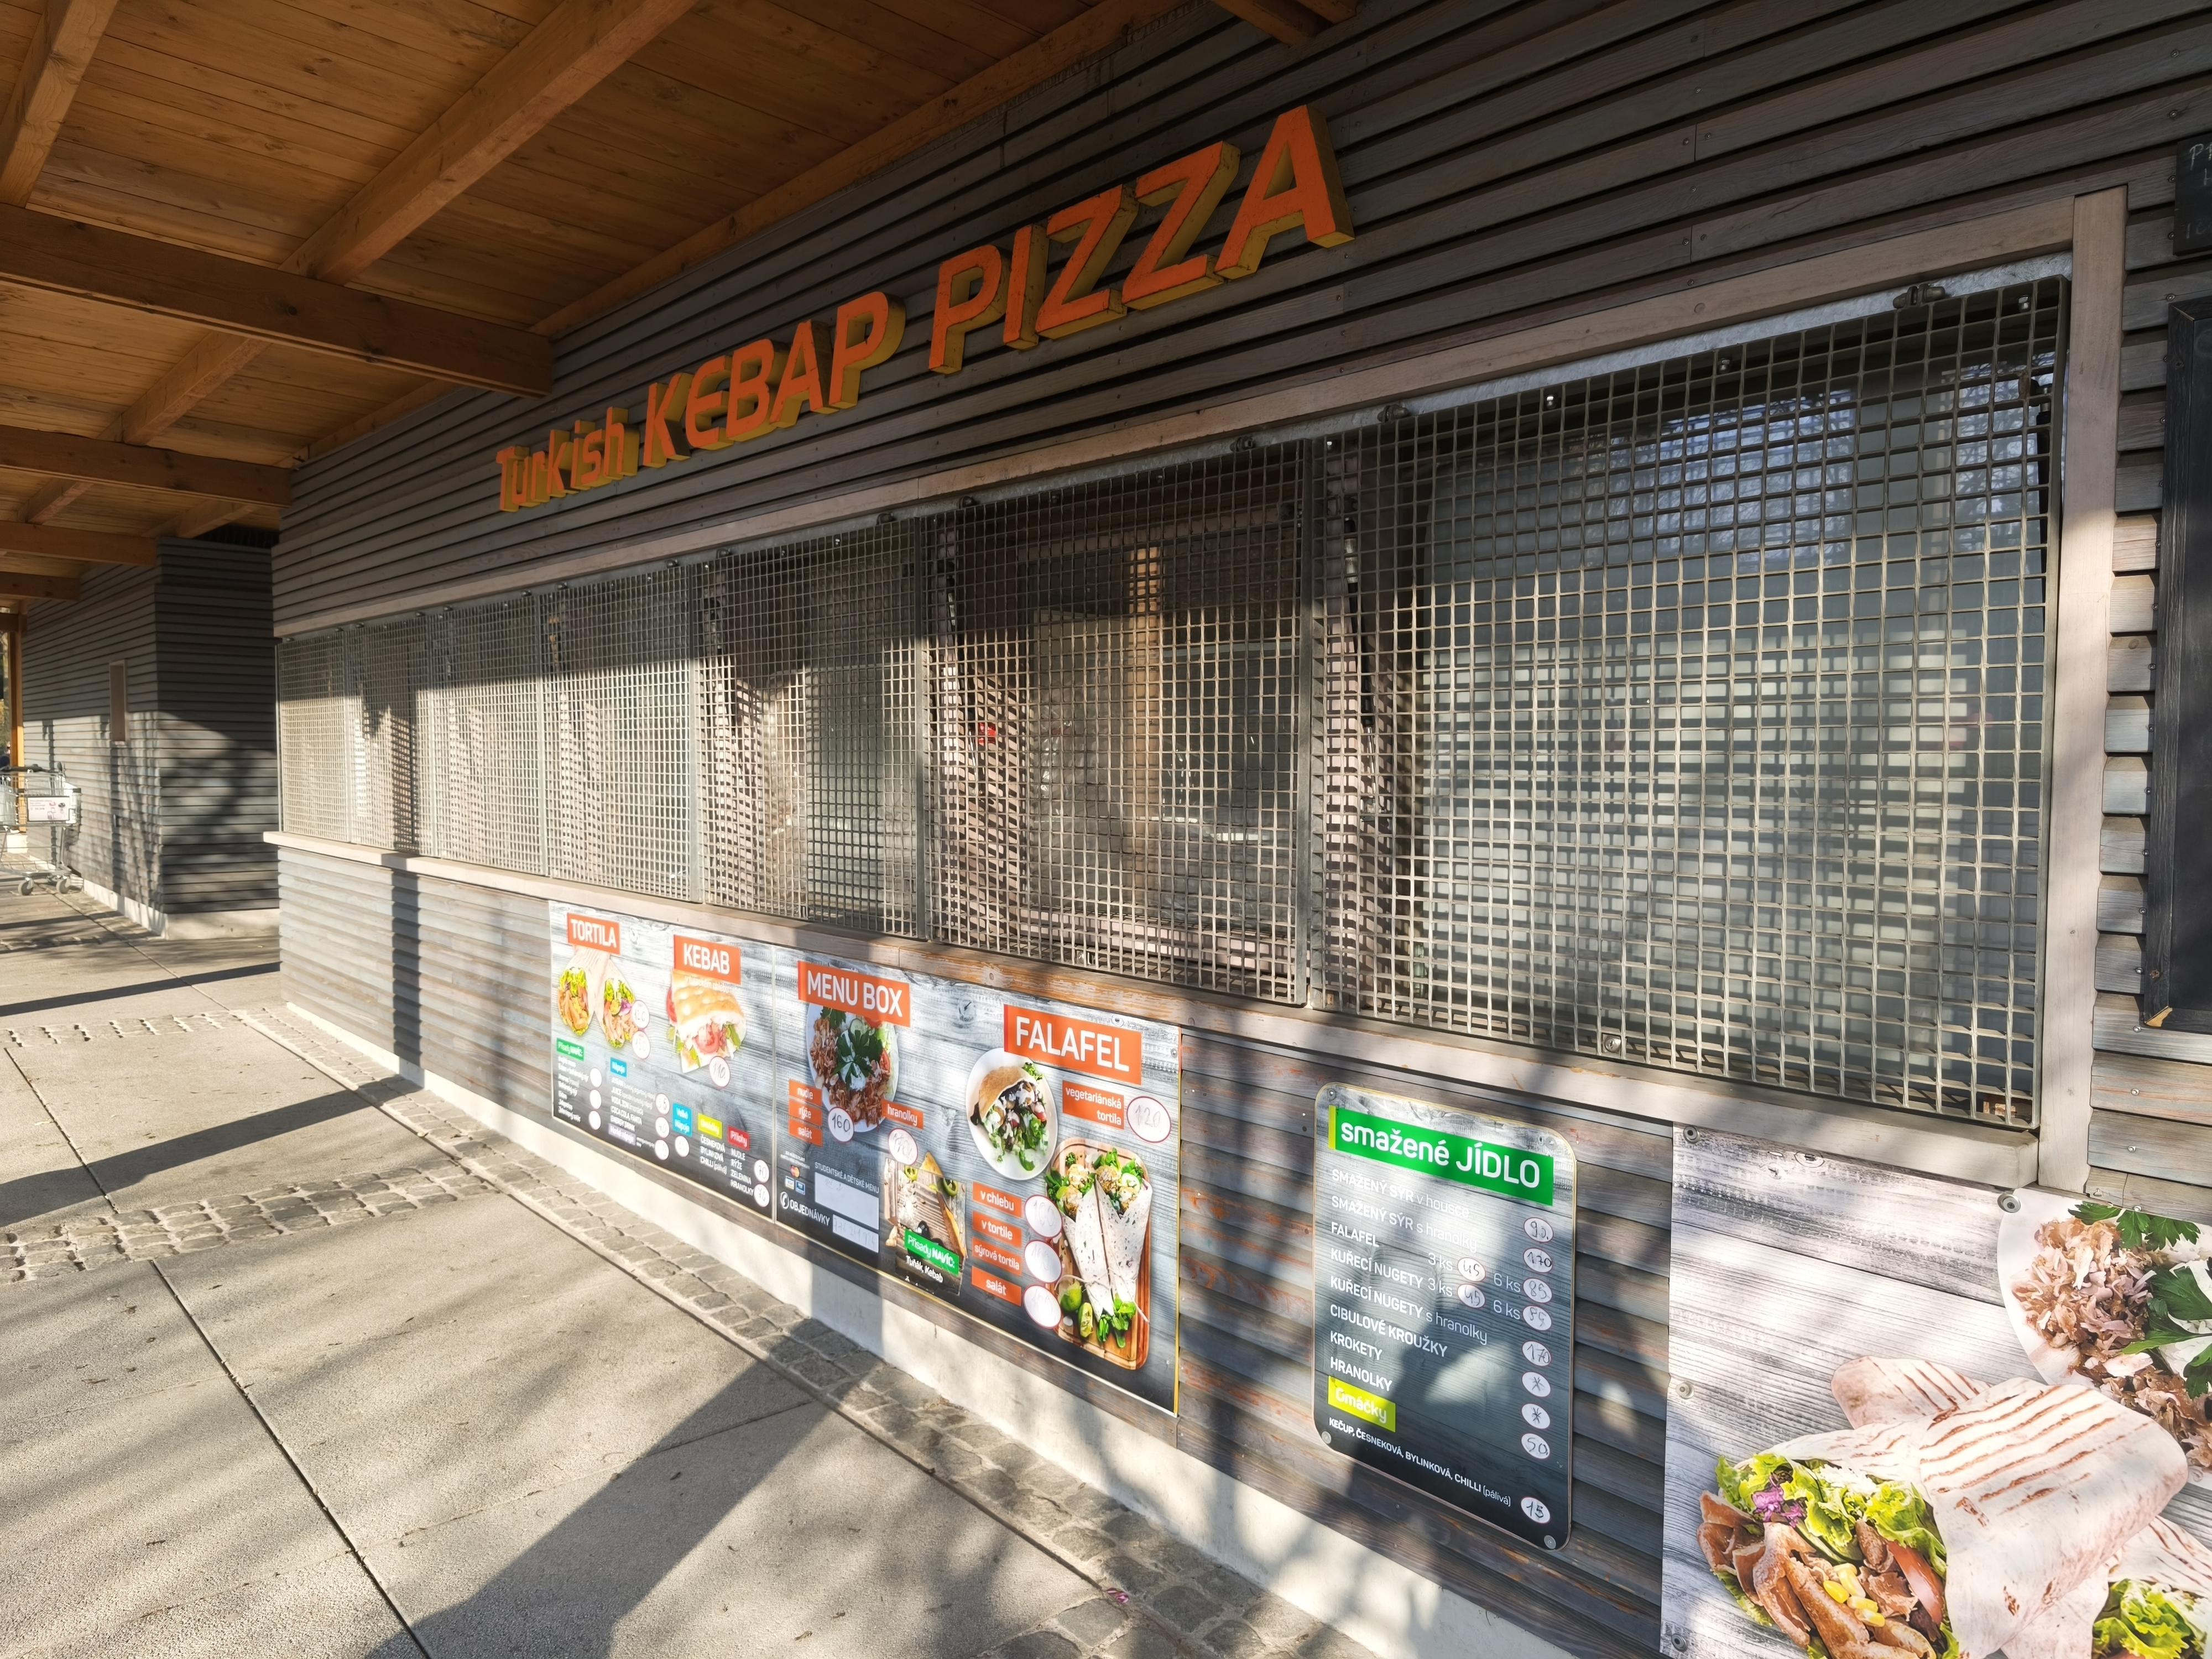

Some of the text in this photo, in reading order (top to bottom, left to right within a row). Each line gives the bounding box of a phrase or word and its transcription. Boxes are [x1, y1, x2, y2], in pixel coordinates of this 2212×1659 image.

[497, 105, 1354, 512] Turkish KEBAP PIZZA
[571, 919, 617, 948] TORTILA
[683, 943, 730, 975] KEBAB
[807, 969, 903, 1017] MENU BOX
[1016, 1016, 1129, 1072] FALAFEL
[797, 1087, 813, 1100] nudle
[1065, 1087, 1121, 1109] vegetariánská
[887, 1104, 917, 1126] hranolky
[1097, 1109, 1121, 1126] tortila
[730, 1130, 748, 1147] Přílohy
[797, 1127, 812, 1139] salát
[731, 1148, 745, 1161] NUDLE
[1340, 1121, 1540, 1188] smažené JÍDLO
[730, 1169, 752, 1185] ZELENINA
[730, 1178, 754, 1196] HRANOLKY
[815, 1162, 843, 1180] STUDENTSKÉ
[847, 1174, 865, 1188] DĚTSKÉ
[865, 1182, 879, 1194] MENU
[980, 1190, 1014, 1211] v chlebu
[1332, 1168, 1387, 1194] SMAŽENÝ
[1389, 1183, 1414, 1202] SÝR
[1416, 1195, 1423, 1204] v
[1426, 1194, 1469, 1218] housce
[789, 1199, 830, 1226] OBJEDNÁVKY
[1331, 1195, 1387, 1222] SMAŽENÝ
[1389, 1212, 1413, 1230] SÝR
[1416, 1223, 1423, 1233] s
[1427, 1222, 1478, 1253] hranolky
[981, 1219, 1013, 1240] v tortile
[908, 1234, 955, 1269] Přísady NAVÍC:
[974, 1244, 998, 1261] sýrová
[998, 1253, 1020, 1271] tortila
[1331, 1221, 1379, 1248] FALAFEL
[1428, 1252, 1436, 1266] 3
[1439, 1255, 1453, 1271] ks
[1494, 1272, 1503, 1286] 6
[1506, 1275, 1521, 1293] ks
[906, 1255, 943, 1283] Tuňák, Kebab
[985, 1278, 1006, 1296] salát
[1330, 1248, 1372, 1272] KUŘECÍ
[1374, 1261, 1423, 1289] NUGETY
[1428, 1277, 1436, 1291] 3
[1439, 1280, 1453, 1297] ks
[1493, 1300, 1502, 1313] 6
[1506, 1302, 1521, 1320] ks
[1330, 1274, 1372, 1301] KUŘECÍ
[1373, 1290, 1423, 1318] NUGETY
[1426, 1311, 1433, 1322] s
[1436, 1312, 1487, 1345] hranolky
[1330, 1304, 1448, 1358] CIBULOVÉ KROUŽKY
[1330, 1330, 1383, 1360] KROKETY
[1330, 1356, 1392, 1392] HRANOLKY
[1329, 1417, 1544, 1519] KEČUP, ČESNEKOVÁ, BYLINKOVÁ, CHILLI (pálivá) 15
